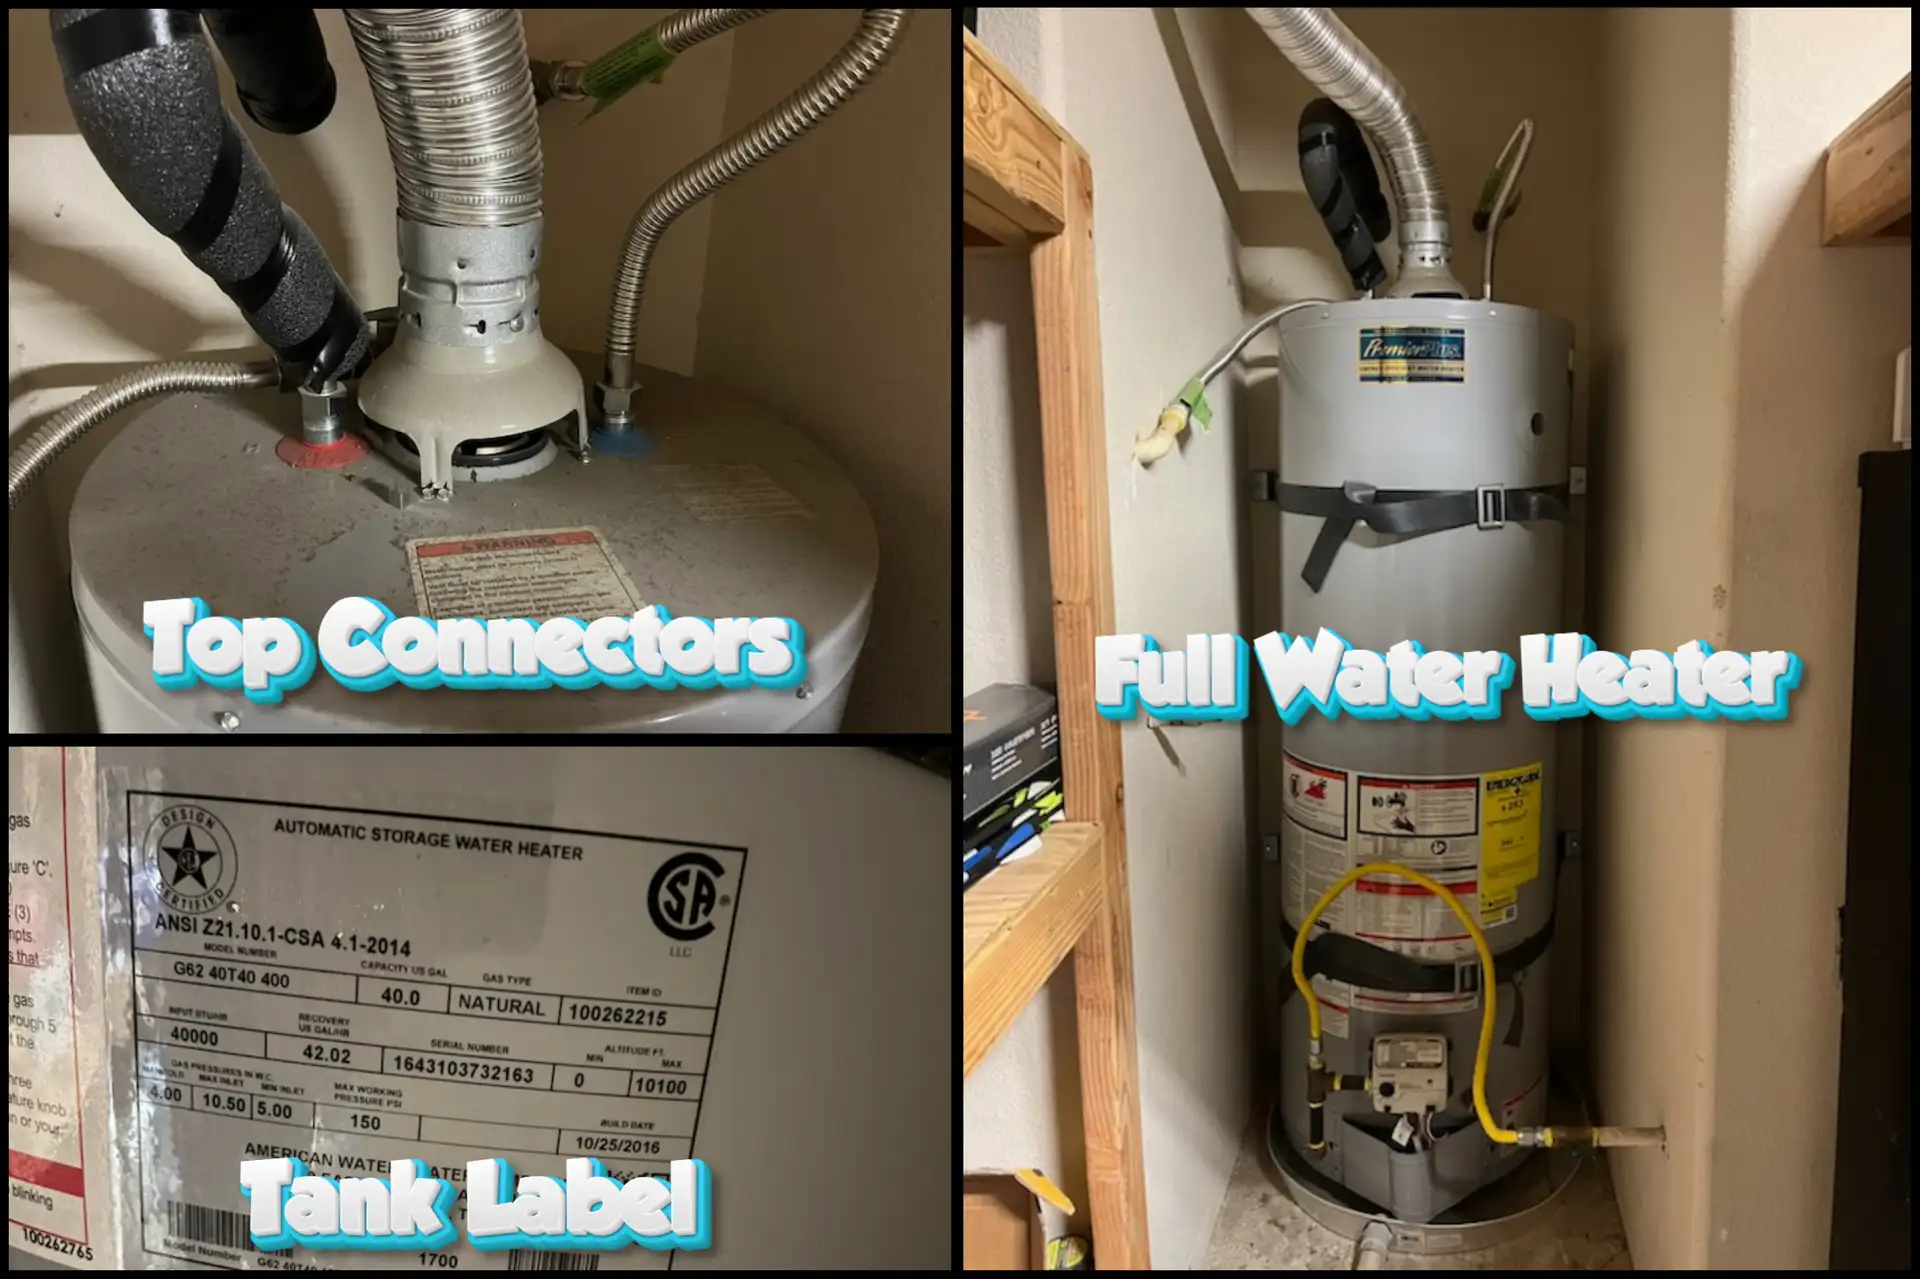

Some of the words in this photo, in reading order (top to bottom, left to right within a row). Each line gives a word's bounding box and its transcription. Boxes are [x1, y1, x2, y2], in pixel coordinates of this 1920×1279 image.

[9, 814, 30, 831] gas
[161, 808, 216, 829] DESIGN
[274, 819, 366, 841] AUTOMATIC
[371, 827, 451, 848] STORAGE
[455, 835, 513, 855] WATER
[518, 842, 583, 861] HEATER
[156, 882, 224, 911] CERTIFIED
[14, 904, 31, 923] (3)
[155, 913, 198, 934] ANSI
[203, 918, 325, 948] Z21.10.1-CSA
[331, 936, 412, 957] 4.1-2014
[17, 951, 39, 966] that
[204, 943, 234, 954] MODEL
[237, 947, 278, 958] NUMBER
[669, 946, 692, 958] LLC
[174, 961, 203, 977] G62
[209, 966, 256, 984] 40T40
[261, 972, 290, 989] 400
[482, 973, 504, 984] GAS
[507, 976, 532, 986] TYPE
[381, 987, 420, 1006] 40.0
[626, 986, 650, 997] ITEM
[13, 993, 34, 1008] gas
[459, 994, 545, 1016] NATURAL
[298, 1013, 350, 1026] RECOVERY
[569, 1004, 668, 1026] 100262215
[48, 1020, 56, 1033] 5
[298, 1024, 312, 1033] US
[16, 1035, 35, 1051] the
[171, 1025, 219, 1046] 40000
[303, 1045, 351, 1064] 42.02
[430, 1039, 465, 1051] SERIAL
[467, 1043, 510, 1055] NUMBER
[605, 1044, 649, 1056] ALTITUDE
[586, 1054, 604, 1063] MIN
[661, 1059, 682, 1069] MAX
[171, 1060, 189, 1069] GAS
[191, 1061, 242, 1077] PRESSURES
[393, 1055, 534, 1084] 1643103732163
[574, 1073, 584, 1087] 0
[635, 1077, 687, 1096] 10100
[150, 1084, 182, 1101] 4.00
[334, 1082, 356, 1093] MAX
[358, 1085, 402, 1098] WORKING
[37, 1098, 66, 1117] knob
[203, 1093, 246, 1113] 10.50
[334, 1093, 383, 1107] PRESSURE
[385, 1099, 402, 1108] PSI
[257, 1101, 293, 1120] 5.00
[20, 1116, 31, 1128] or
[350, 1114, 381, 1130] 150
[632, 1122, 655, 1131] DATE
[575, 1136, 660, 1154] 10/25/2016
[245, 1142, 333, 1167] AMERICAN
[338, 1155, 390, 1174] WATE
[12, 1184, 53, 1211] blinking
[23, 1227, 93, 1261] 100262765
[198, 1243, 242, 1262] Number
[257, 1258, 283, 1269] G62
[419, 1252, 458, 1268] 1700
